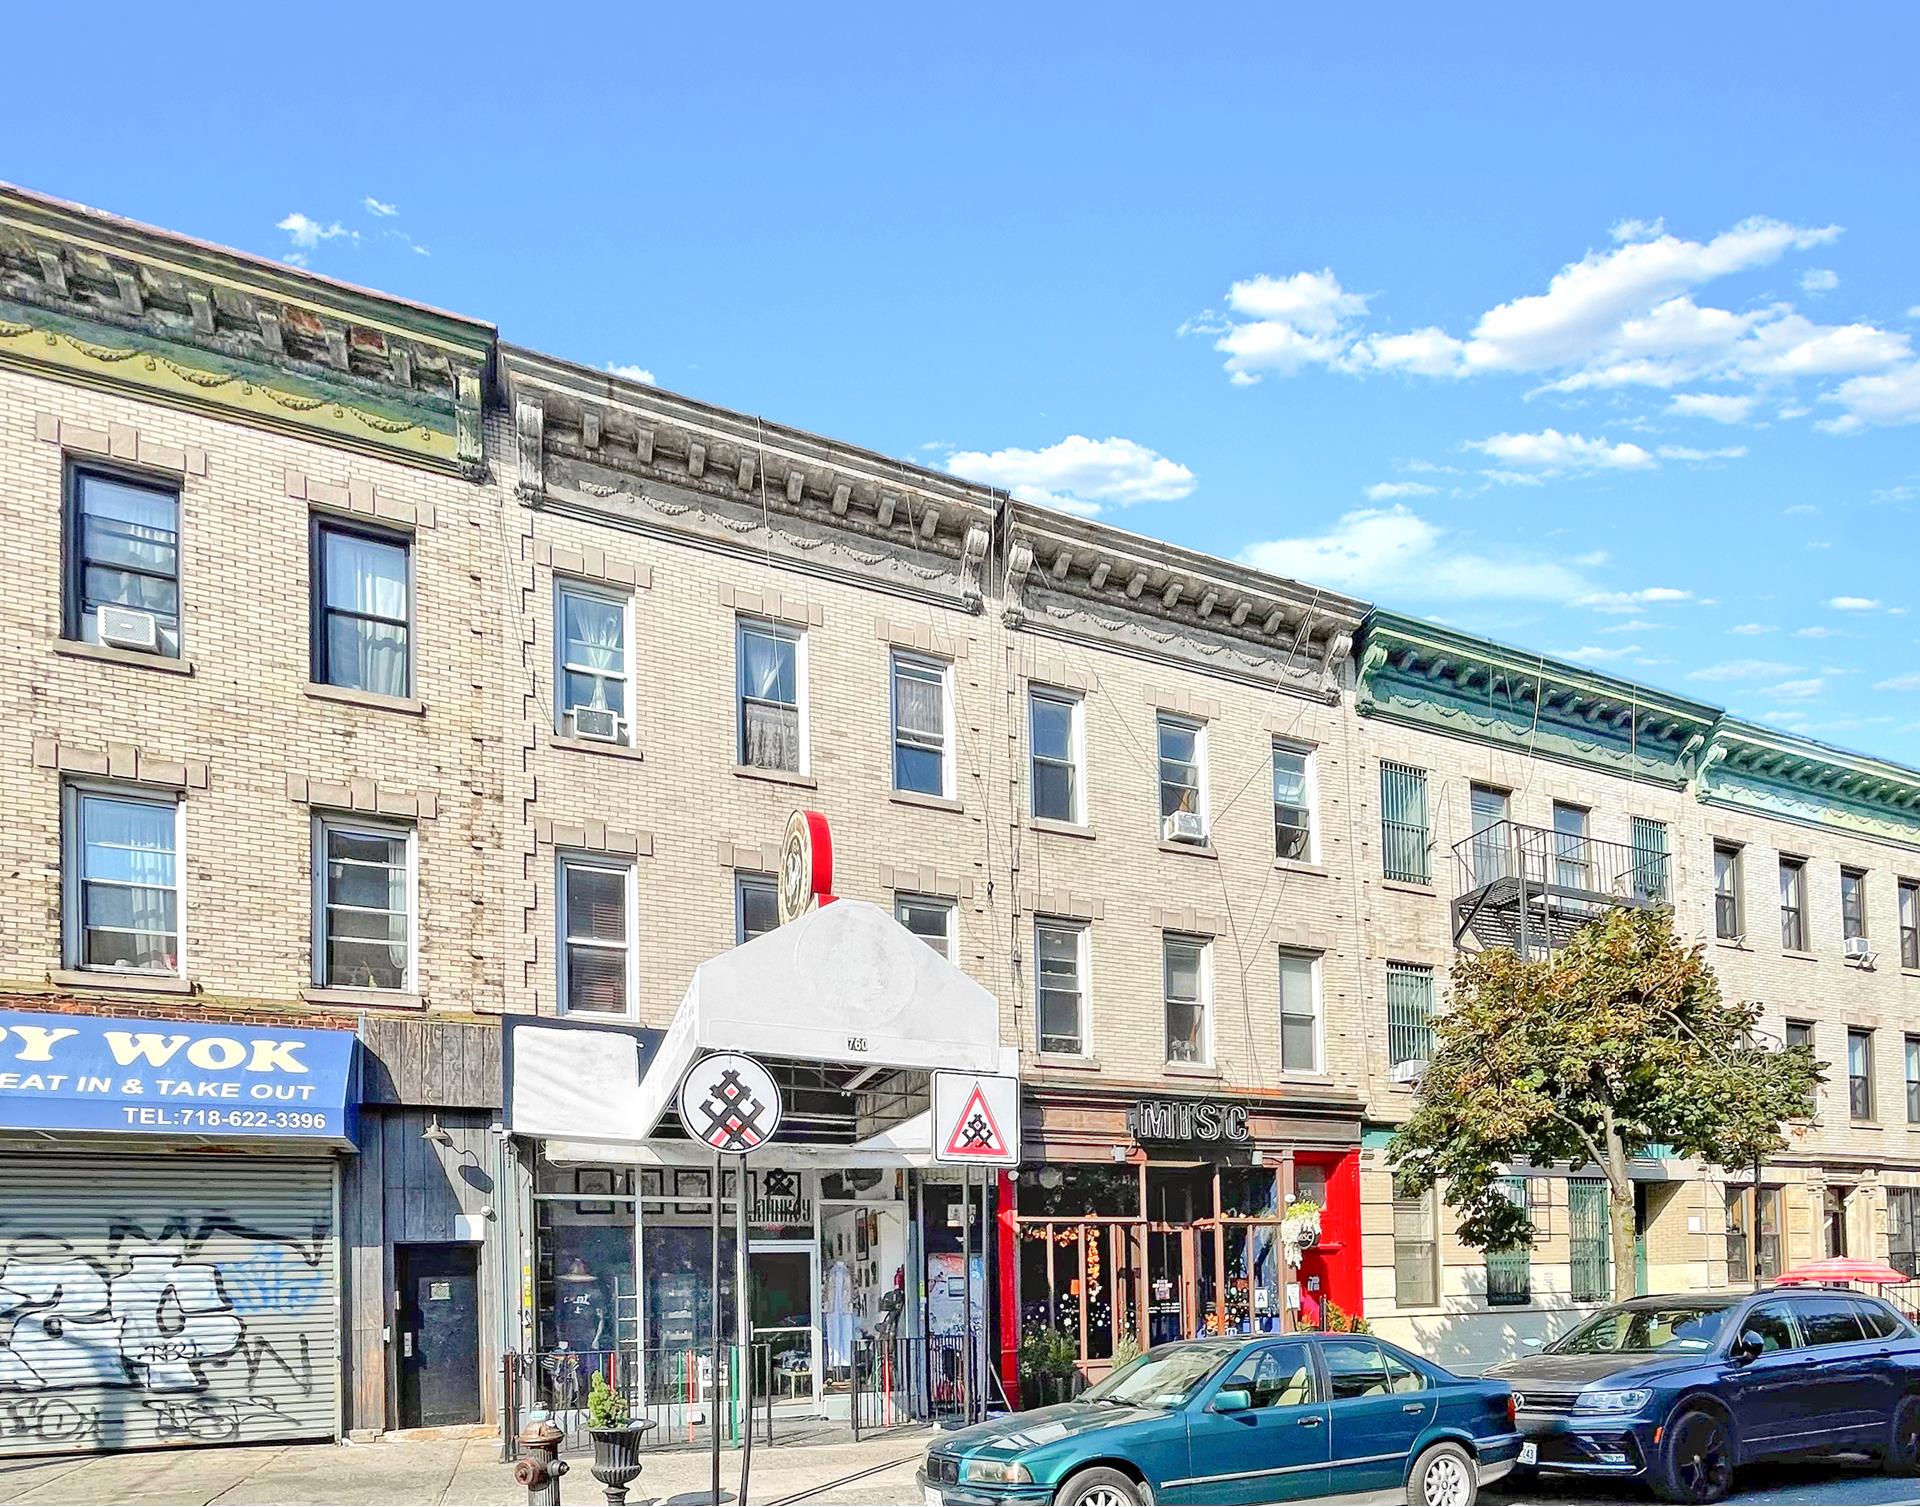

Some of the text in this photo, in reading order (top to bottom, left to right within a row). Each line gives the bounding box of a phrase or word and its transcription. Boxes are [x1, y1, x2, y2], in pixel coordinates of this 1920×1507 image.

[0, 1025, 309, 1073] Y WOK
[847, 1037, 868, 1051] 760
[0, 1072, 316, 1101] EAT IN & TAKE OUT
[123, 1107, 327, 1129] TEL:718-622-3396
[1139, 1101, 1248, 1141] MISC
